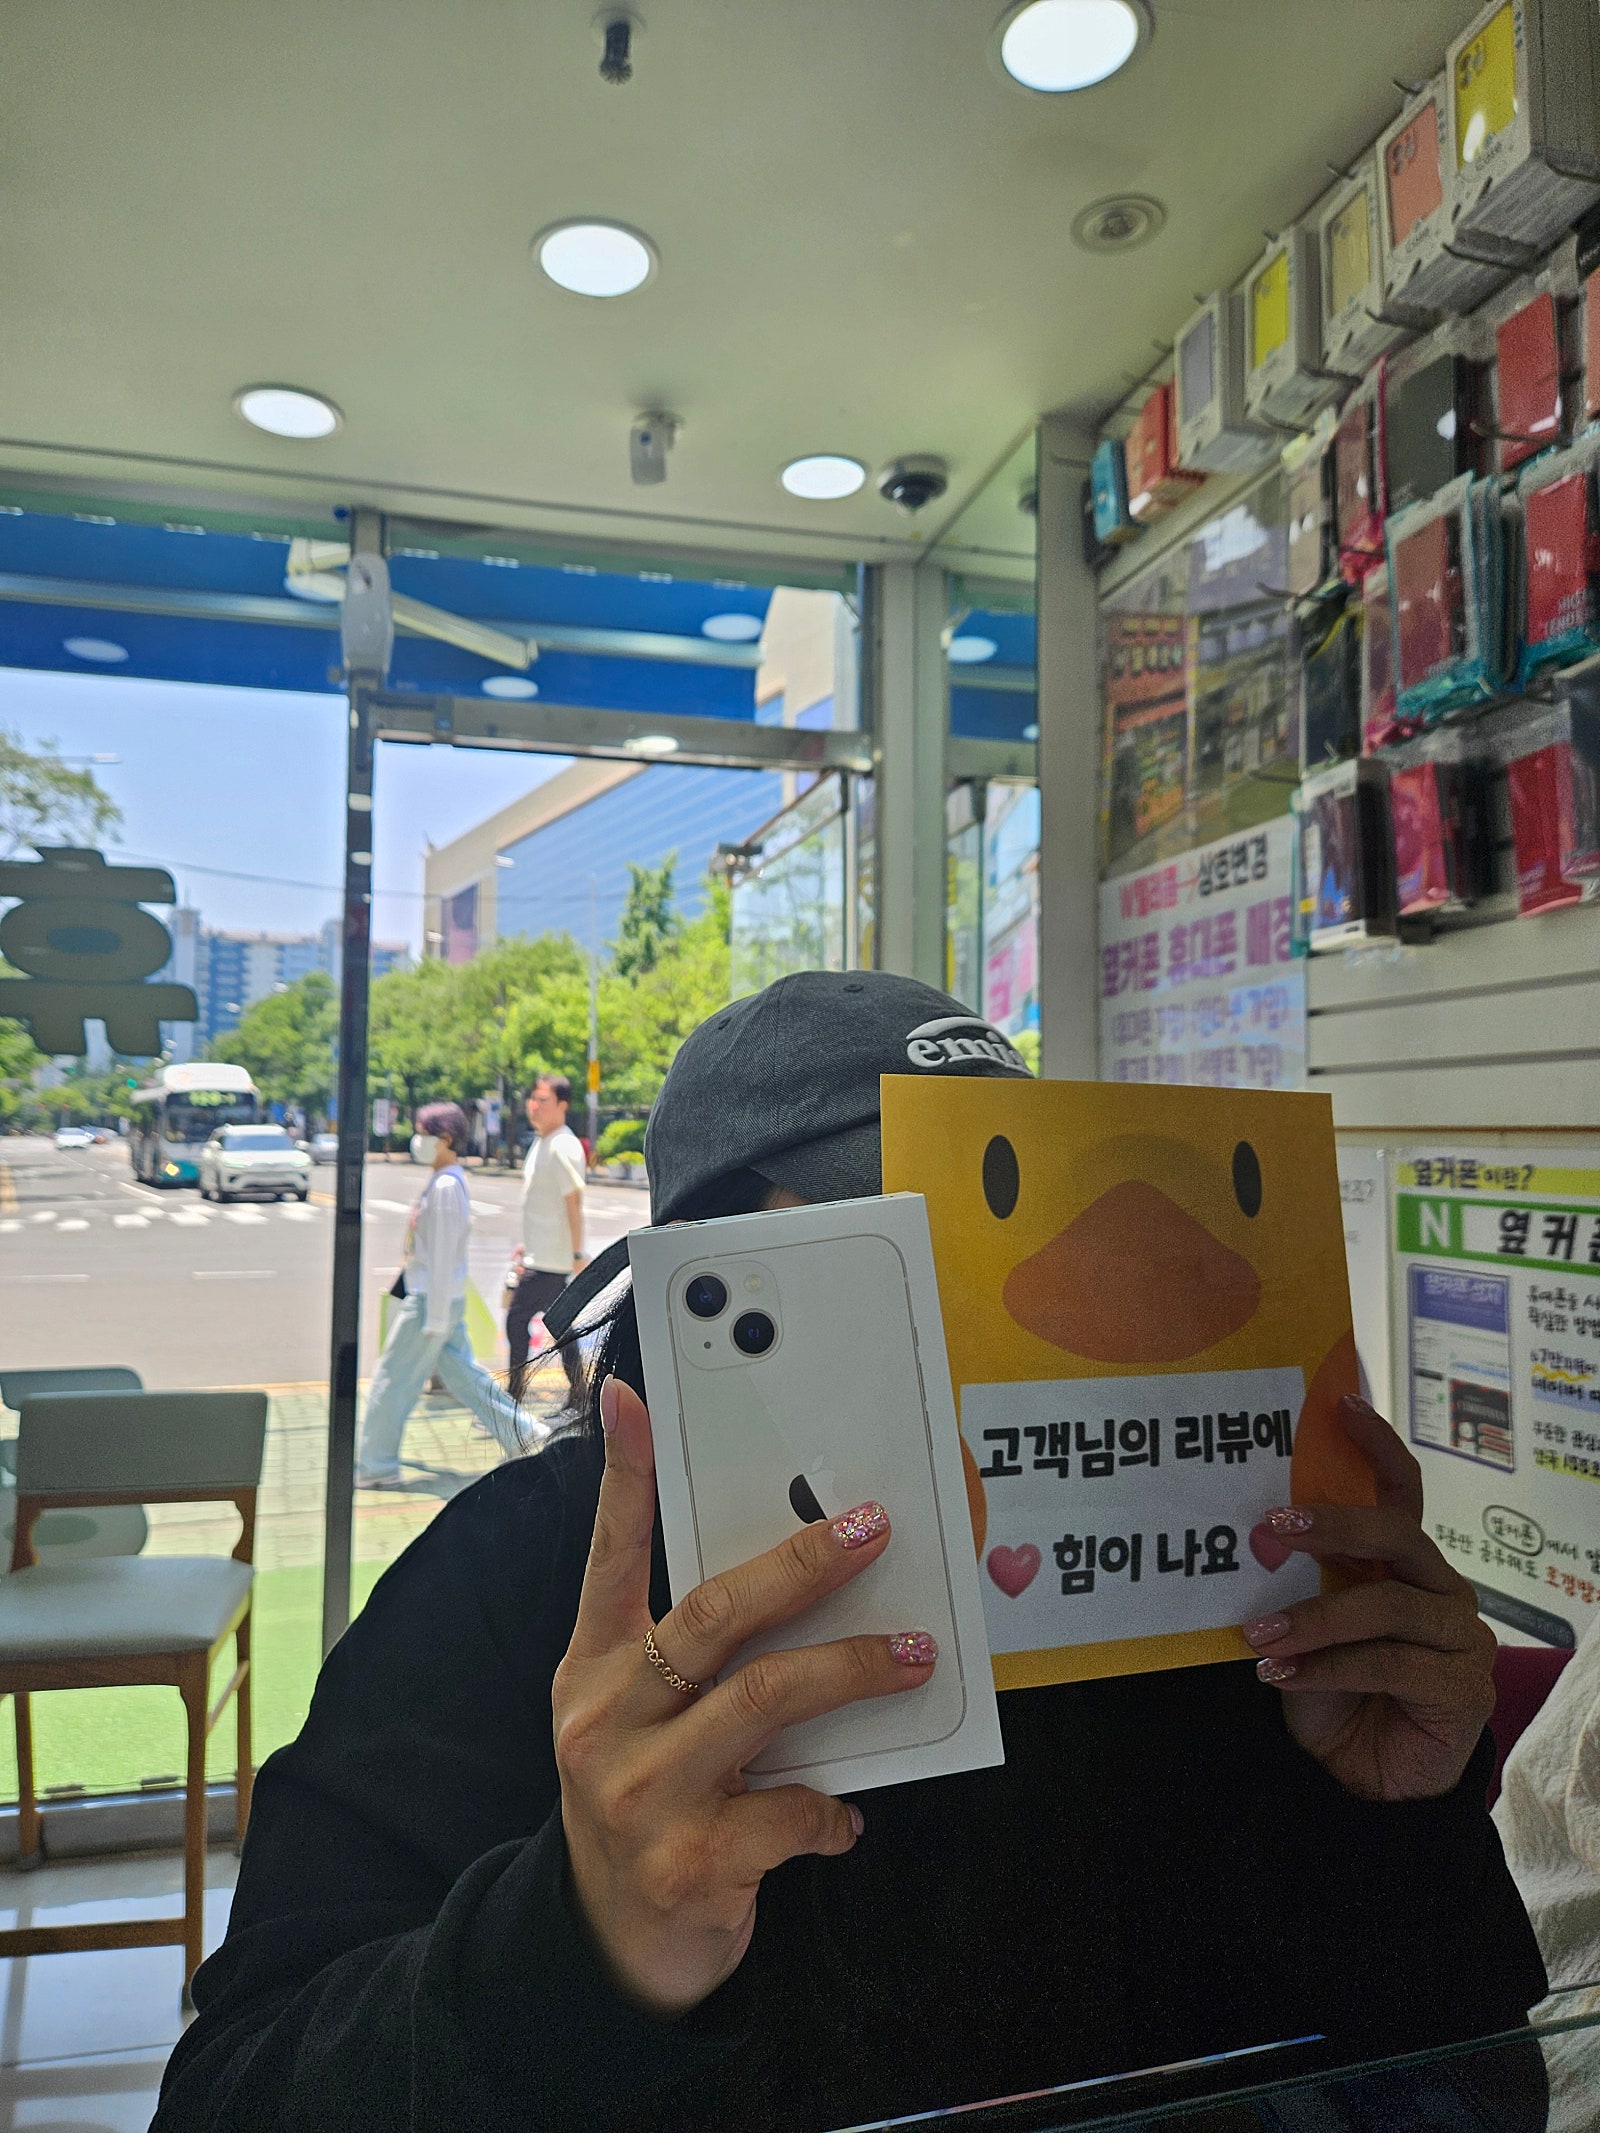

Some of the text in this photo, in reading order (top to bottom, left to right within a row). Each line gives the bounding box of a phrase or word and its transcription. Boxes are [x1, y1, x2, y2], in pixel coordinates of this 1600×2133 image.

[1198, 833, 1269, 898] 상호변경
[1419, 1201, 1450, 1248] N
[980, 1409, 1293, 1479] 고객님의 리뷰에
[1053, 1524, 1240, 1596] 힘이 나요
[1479, 1539, 1540, 1580] 공부해도
